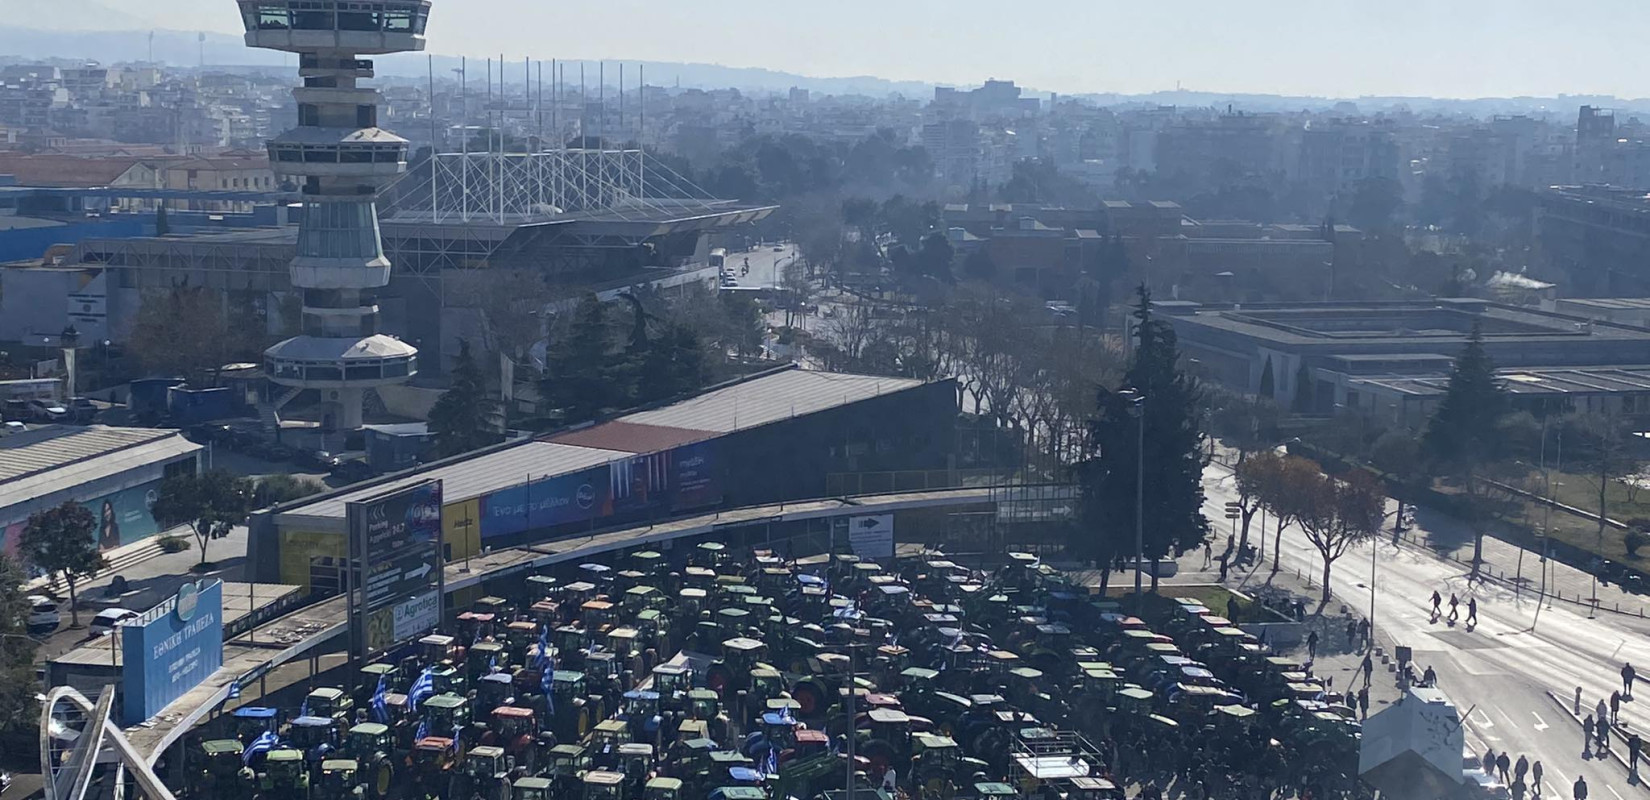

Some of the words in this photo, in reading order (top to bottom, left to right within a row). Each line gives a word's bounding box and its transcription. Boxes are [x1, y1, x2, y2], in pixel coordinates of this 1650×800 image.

[404, 596, 438, 618] Agrotica
[153, 631, 182, 660] ΕΘΝΙΚΗ
[184, 612, 214, 640] ΤΡΑΠΕΖΑ
